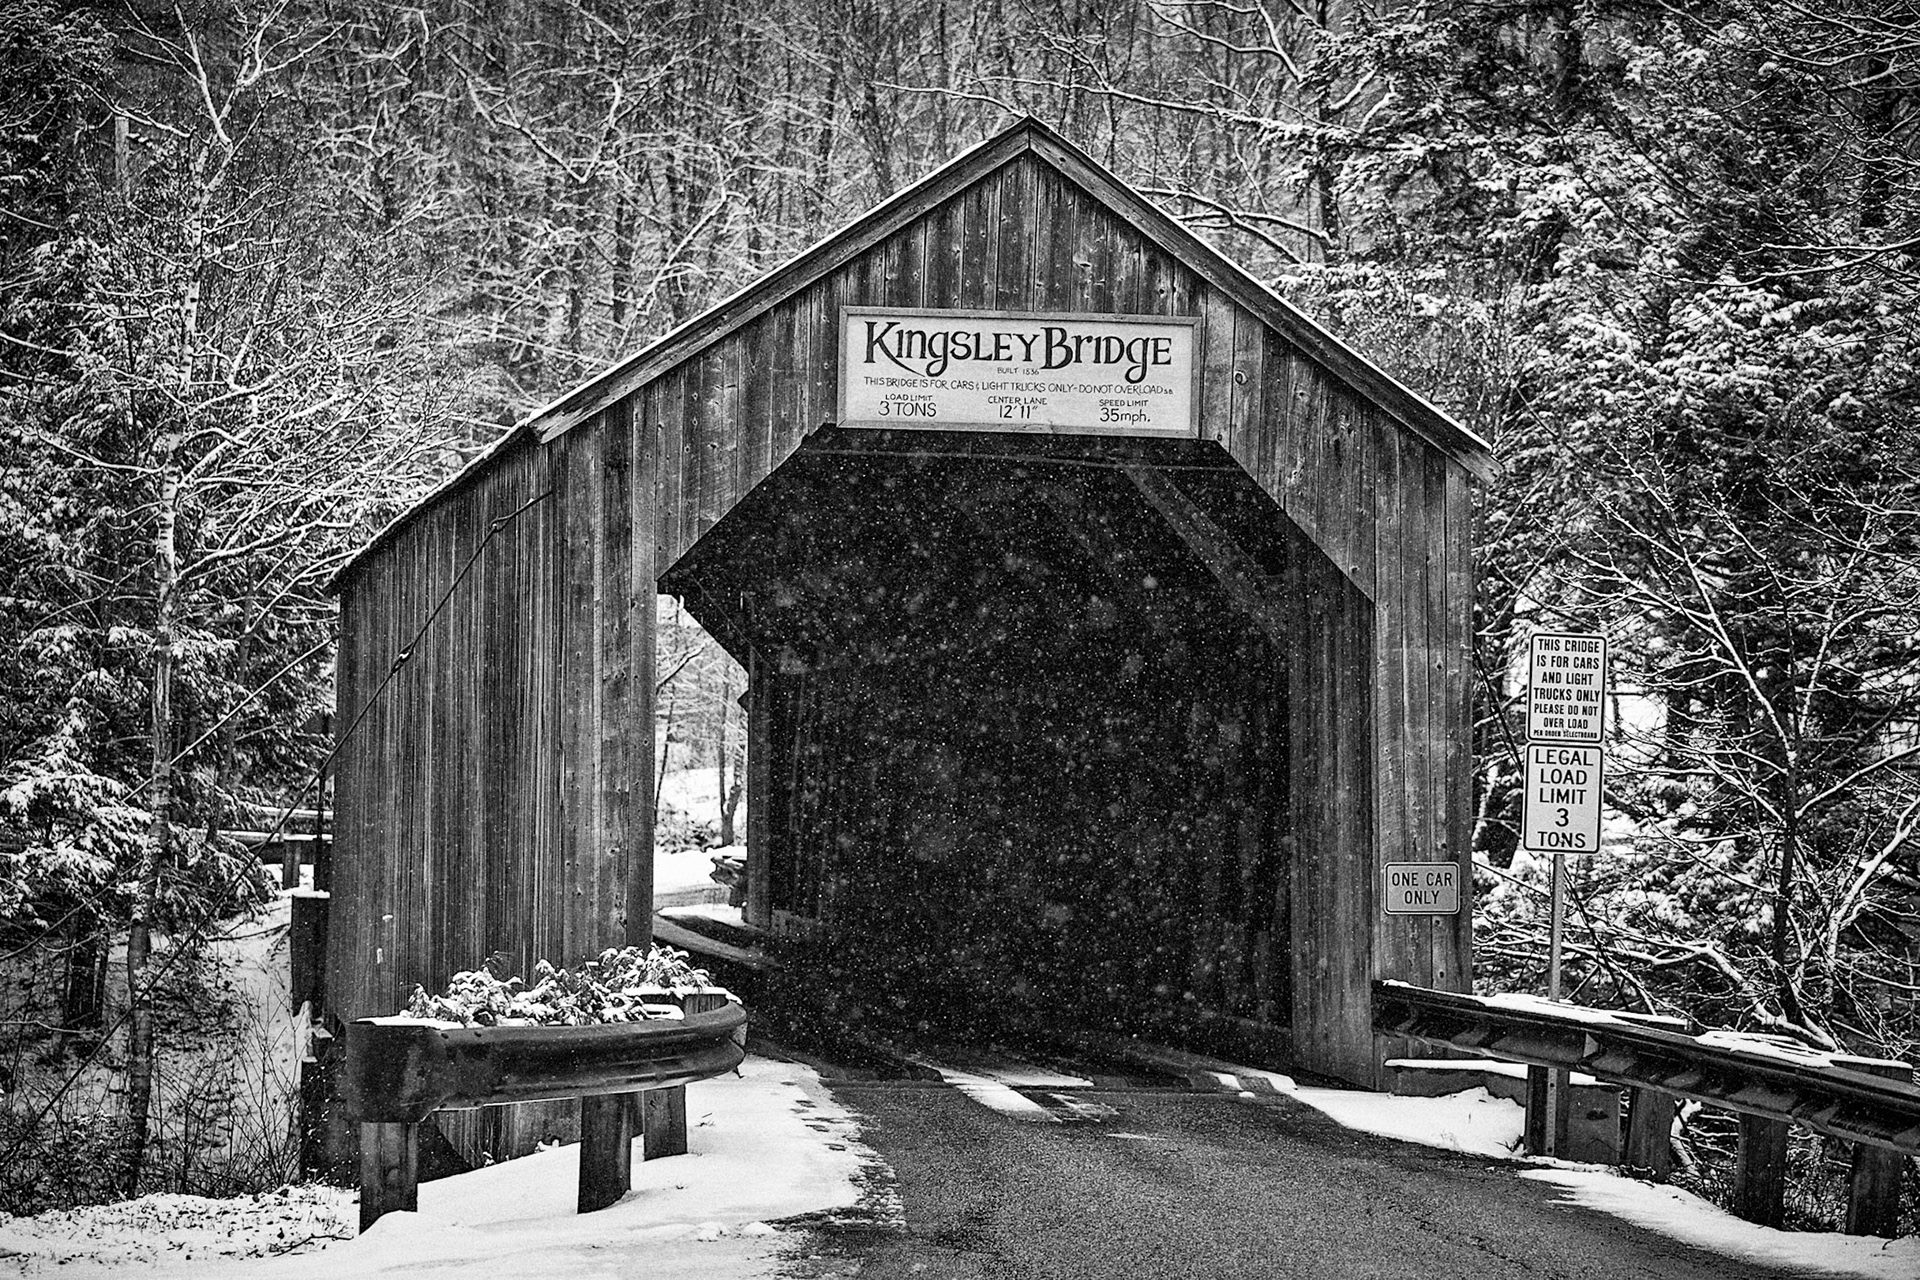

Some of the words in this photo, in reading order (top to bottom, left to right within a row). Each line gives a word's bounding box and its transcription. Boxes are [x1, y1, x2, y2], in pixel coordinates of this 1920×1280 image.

[997, 367, 1018, 375] BUILT
[1022, 368, 1040, 376] 1836
[864, 376, 885, 387] THIS
[885, 378, 918, 388] BRIDGE
[919, 379, 928, 388] IS
[929, 380, 949, 390] FOR
[950, 380, 974, 391] CARS
[981, 381, 1008, 392] LIGHT
[1011, 382, 1046, 393] TRUCKS
[1093, 384, 1113, 395] NOT
[885, 393, 909, 401] LOAD
[910, 394, 933, 402] LIMIT
[987, 396, 1022, 405] CENTER
[1023, 398, 1048, 406] LANE
[1099, 398, 1126, 407] SPEED
[878, 400, 890, 416] 3
[893, 402, 937, 417] TONS
[1538, 638, 1561, 652] THIS
[1536, 654, 1547, 667] IS
[1551, 655, 1570, 669] FOR
[1573, 656, 1600, 670] CARS
[1541, 671, 1562, 684] AND
[1566, 672, 1594, 686] LIGHT
[1533, 687, 1573, 701] TRUCKS
[1576, 689, 1601, 703] ONLY
[1534, 703, 1565, 715] PLEASE
[1567, 704, 1579, 716] DO
[1582, 705, 1599, 717] NOT
[1543, 717, 1564, 729] OVER
[1567, 718, 1589, 730] LOAD
[1535, 748, 1594, 766] LEGAL
[1540, 768, 1588, 785] LOAD
[1539, 787, 1587, 805] LIMIT
[1555, 807, 1569, 828] 3
[1537, 831, 1586, 849] TONS
[1392, 872, 1419, 887] ONE
[1426, 872, 1453, 887] CAR
[1404, 890, 1440, 905] ONLY
